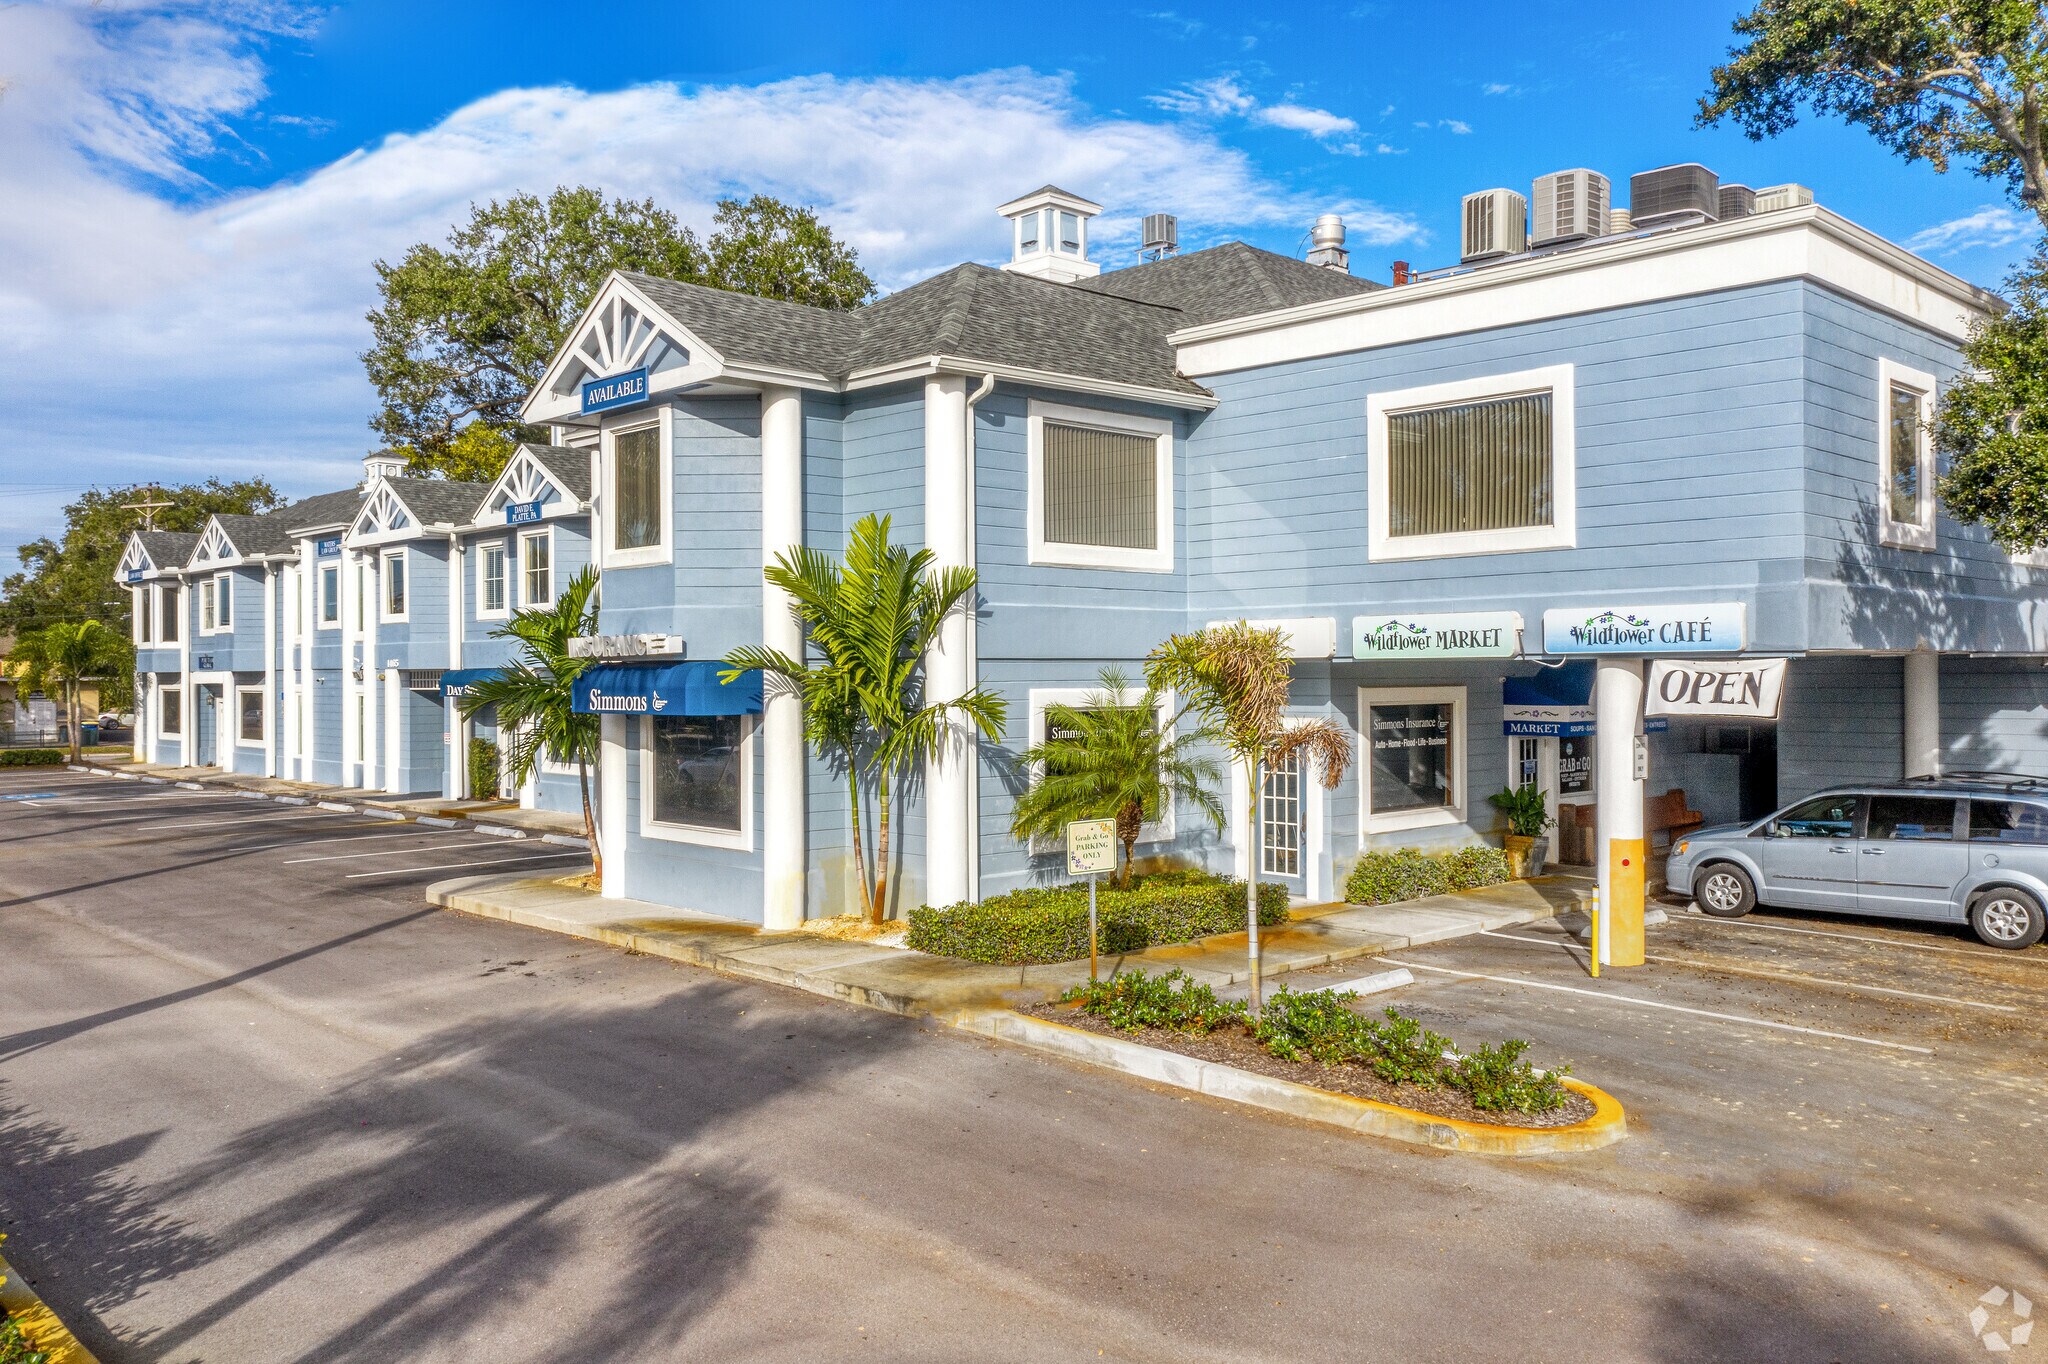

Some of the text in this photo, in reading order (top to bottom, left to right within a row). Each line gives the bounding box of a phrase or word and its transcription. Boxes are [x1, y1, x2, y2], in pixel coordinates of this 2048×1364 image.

[587, 377, 644, 406] AVAILABLE
[514, 504, 529, 514] DAVID
[1571, 617, 1712, 646] Wildflower CAFÉ
[567, 633, 678, 658] INSURANCE
[1365, 628, 1502, 651] Wildflower MARKET
[446, 685, 463, 696] DAY
[1659, 668, 1769, 709] OPEN
[589, 688, 647, 711] Simmons
[1373, 718, 1436, 730] Simmons Insurance
[1510, 723, 1560, 734] MARKET
[1581, 756, 1591, 771] GO
[1076, 842, 1109, 851] PARKING
[1082, 851, 1102, 860] ONLY
